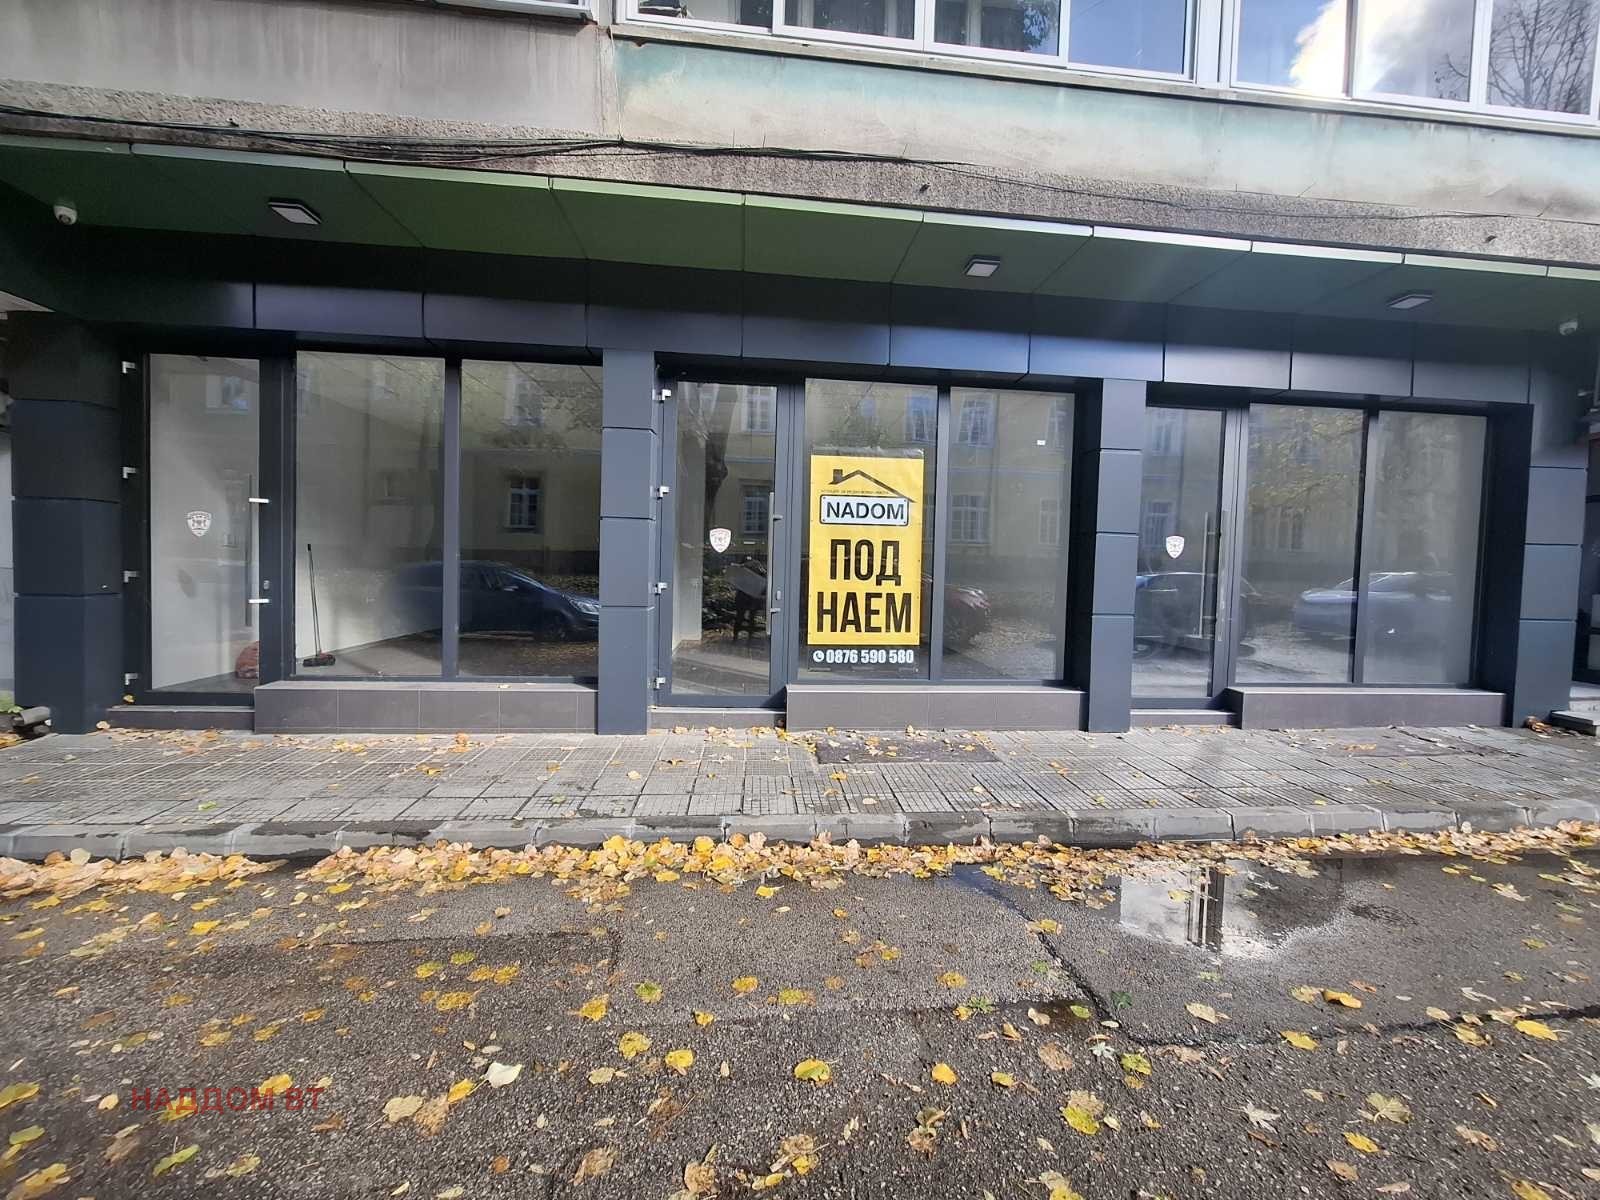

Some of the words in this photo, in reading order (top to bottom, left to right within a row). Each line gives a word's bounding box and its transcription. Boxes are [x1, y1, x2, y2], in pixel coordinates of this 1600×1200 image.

[826, 502, 904, 520] NADOM
[830, 539, 901, 586] ПОД
[817, 592, 911, 632] НАЕМ
[826, 649, 858, 664] 0876
[861, 649, 886, 664] 590
[889, 650, 914, 664] 580
